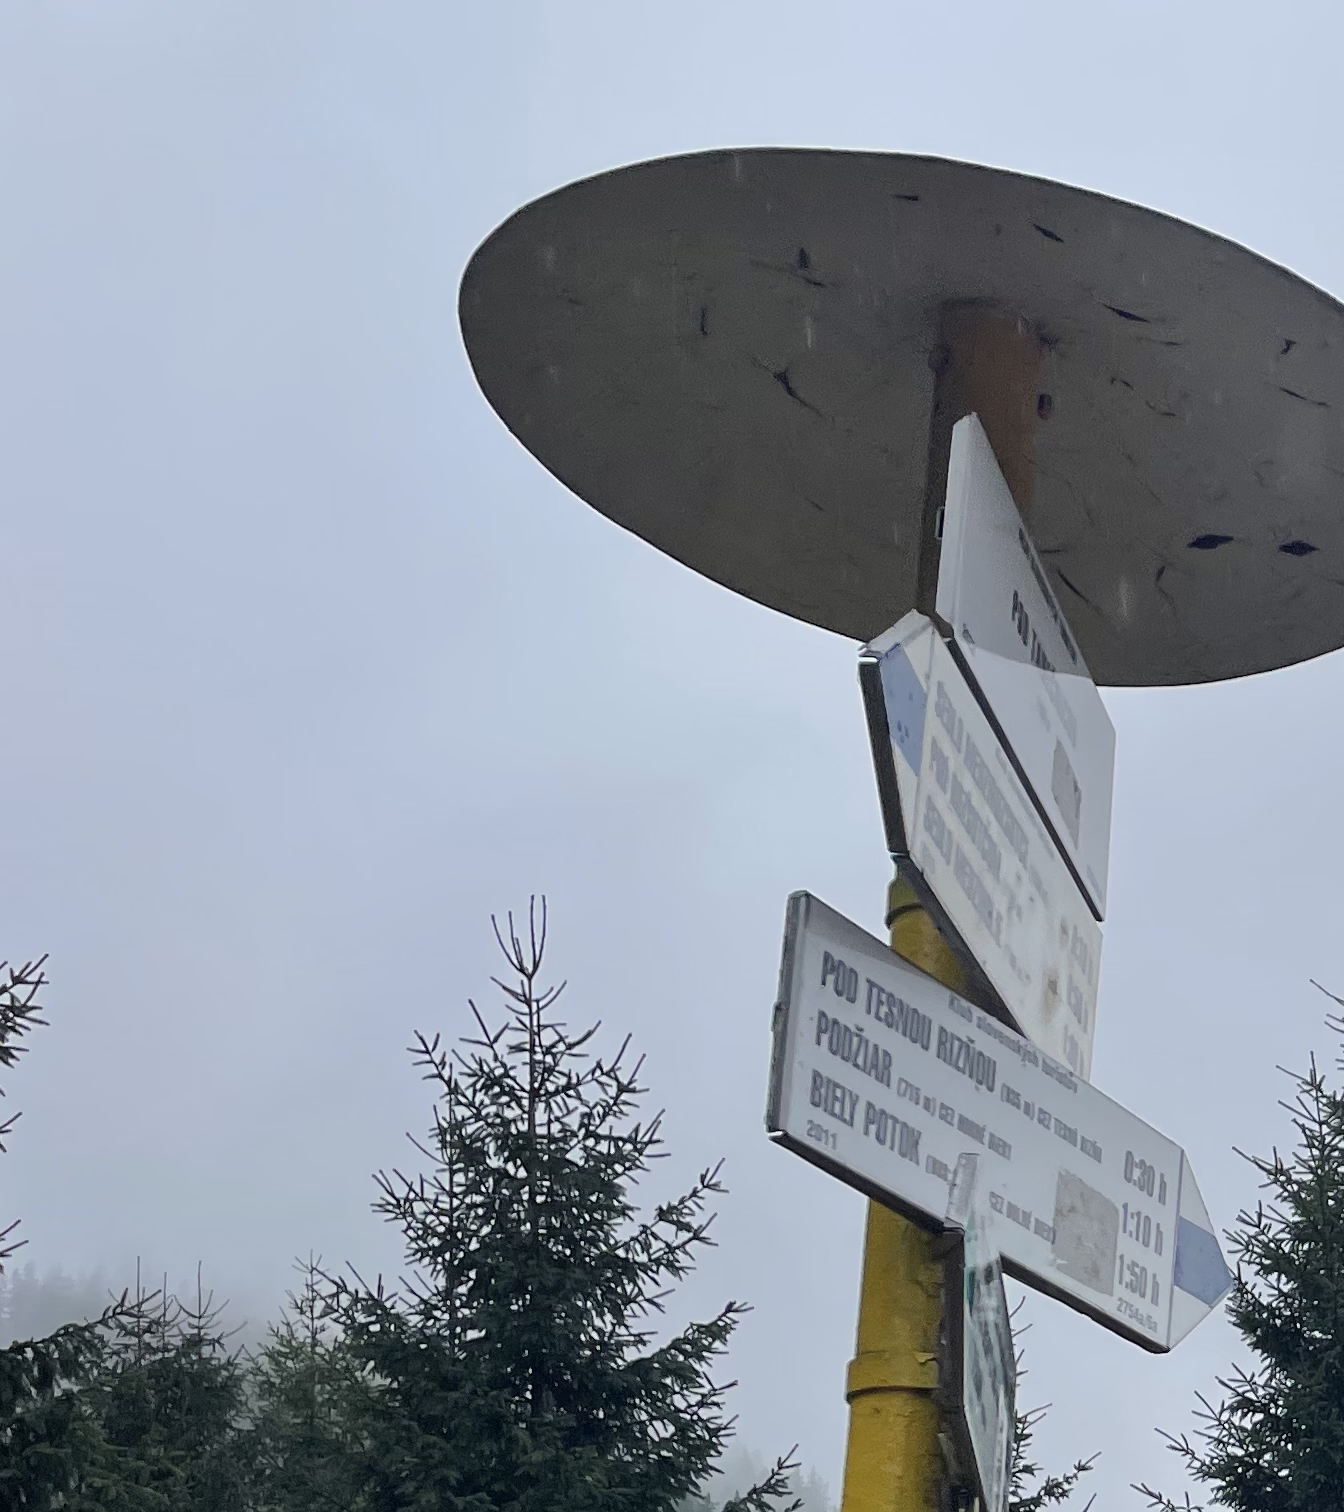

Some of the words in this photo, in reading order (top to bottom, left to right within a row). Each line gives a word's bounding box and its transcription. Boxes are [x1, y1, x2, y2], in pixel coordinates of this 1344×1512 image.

[821, 951, 858, 1003] POD
[866, 978, 932, 1052] TESNOU
[814, 1009, 893, 1090] PODŽIAR
[809, 1067, 860, 1130] BIELY
[863, 1094, 922, 1167] POTOK
[1123, 1150, 1156, 1199] 0:30
[1158, 1172, 1168, 1206] h
[1121, 1202, 1152, 1248] 1:10
[1155, 1222, 1164, 1256] h
[1118, 1253, 1148, 1299] 1:50
[1150, 1272, 1160, 1307] h
